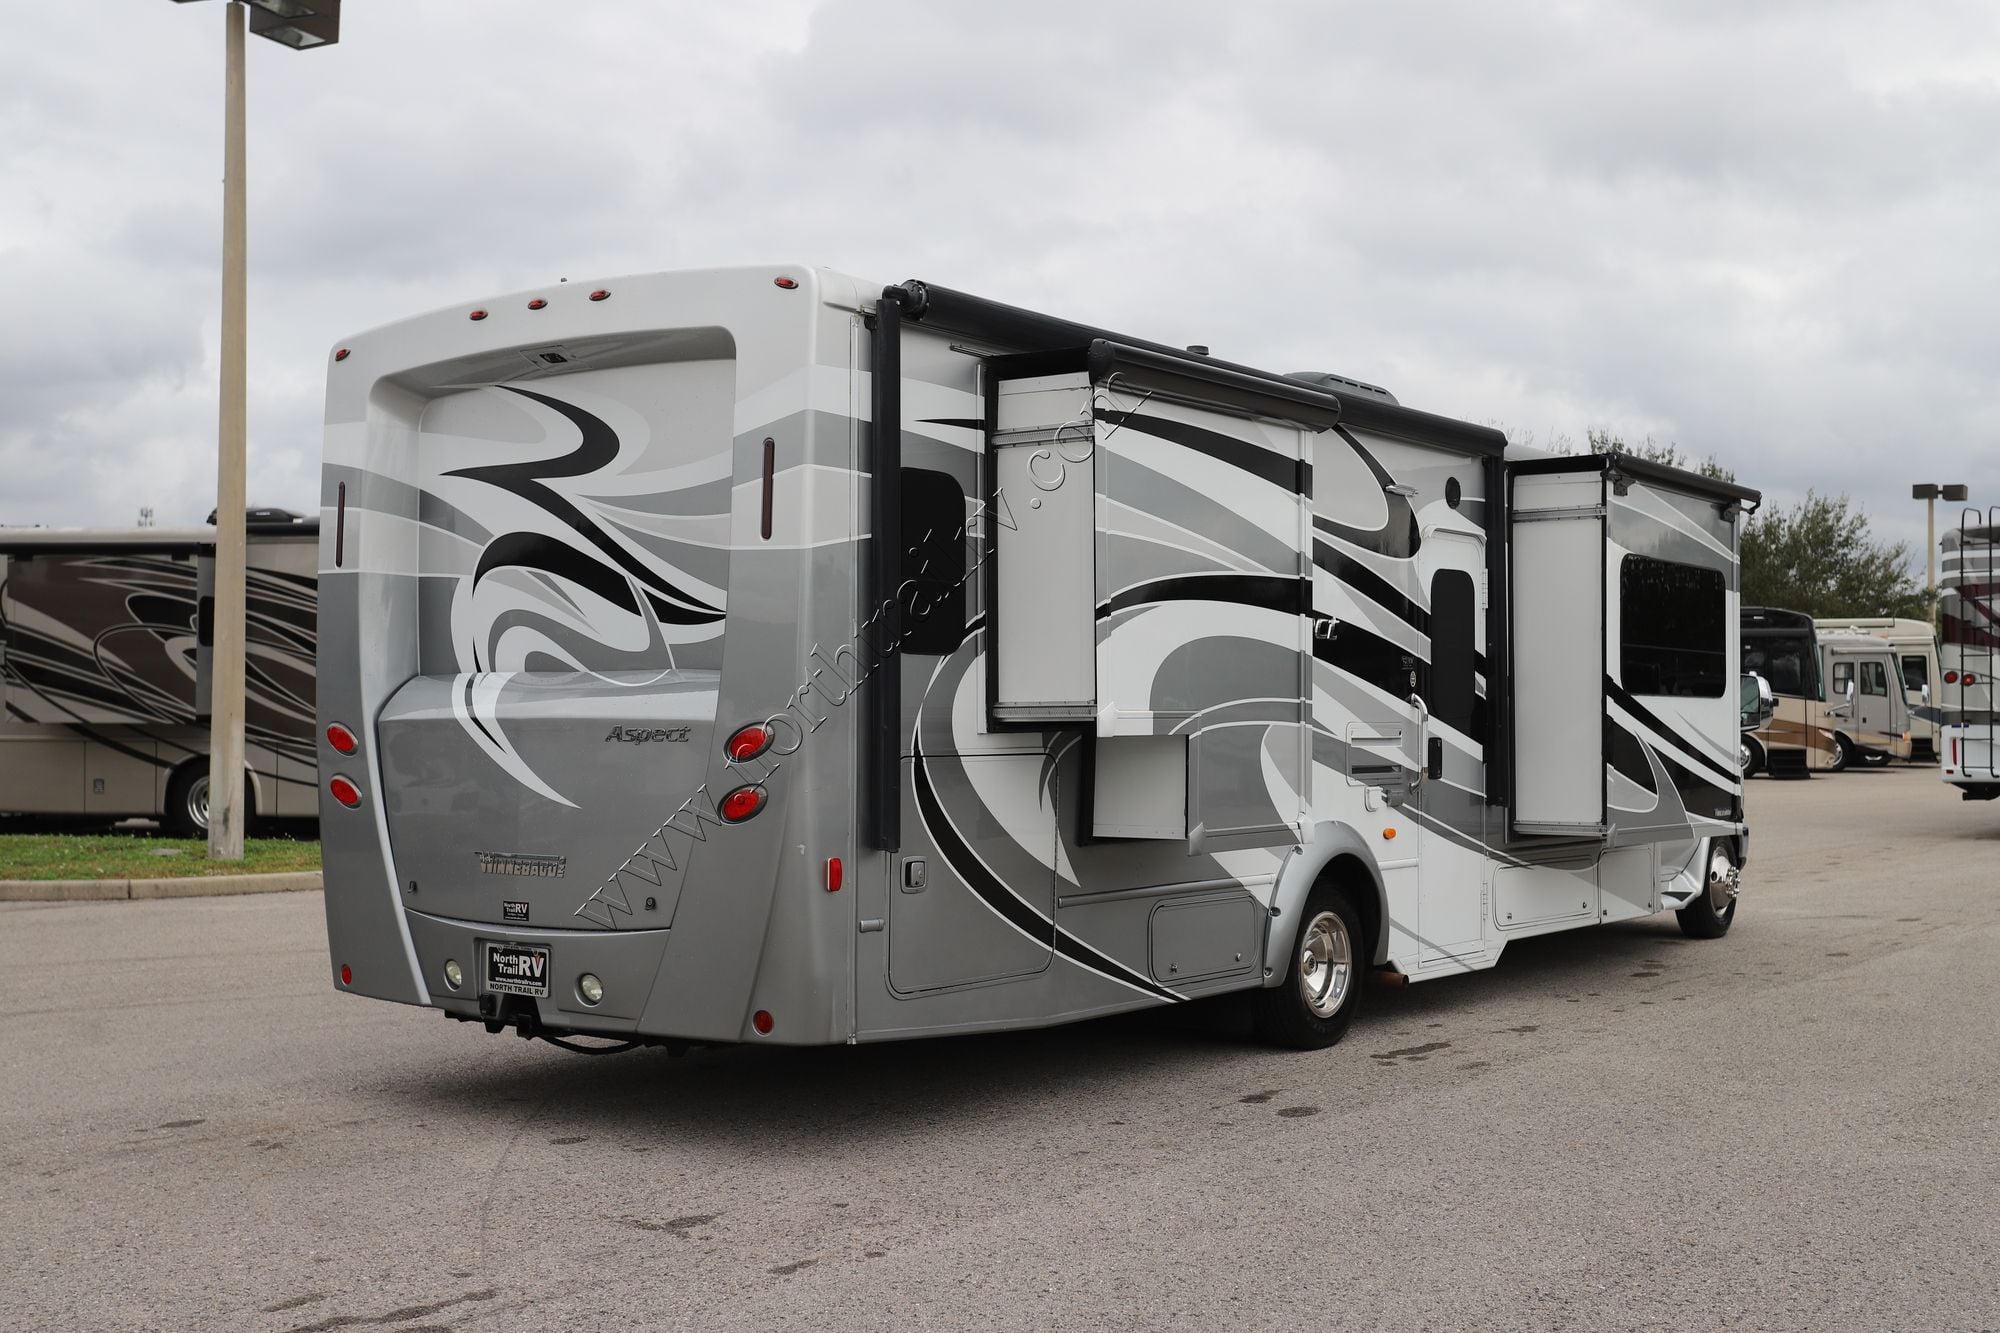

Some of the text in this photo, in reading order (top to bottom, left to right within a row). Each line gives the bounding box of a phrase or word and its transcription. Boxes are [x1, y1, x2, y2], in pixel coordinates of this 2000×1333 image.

[604, 724, 692, 746] Aspect
[515, 903, 528, 914] RV
[493, 952, 518, 964] North
[498, 963, 518, 975] Trail
[519, 955, 545, 977] RV
[490, 983, 545, 996] NORTH TRAIL RV
